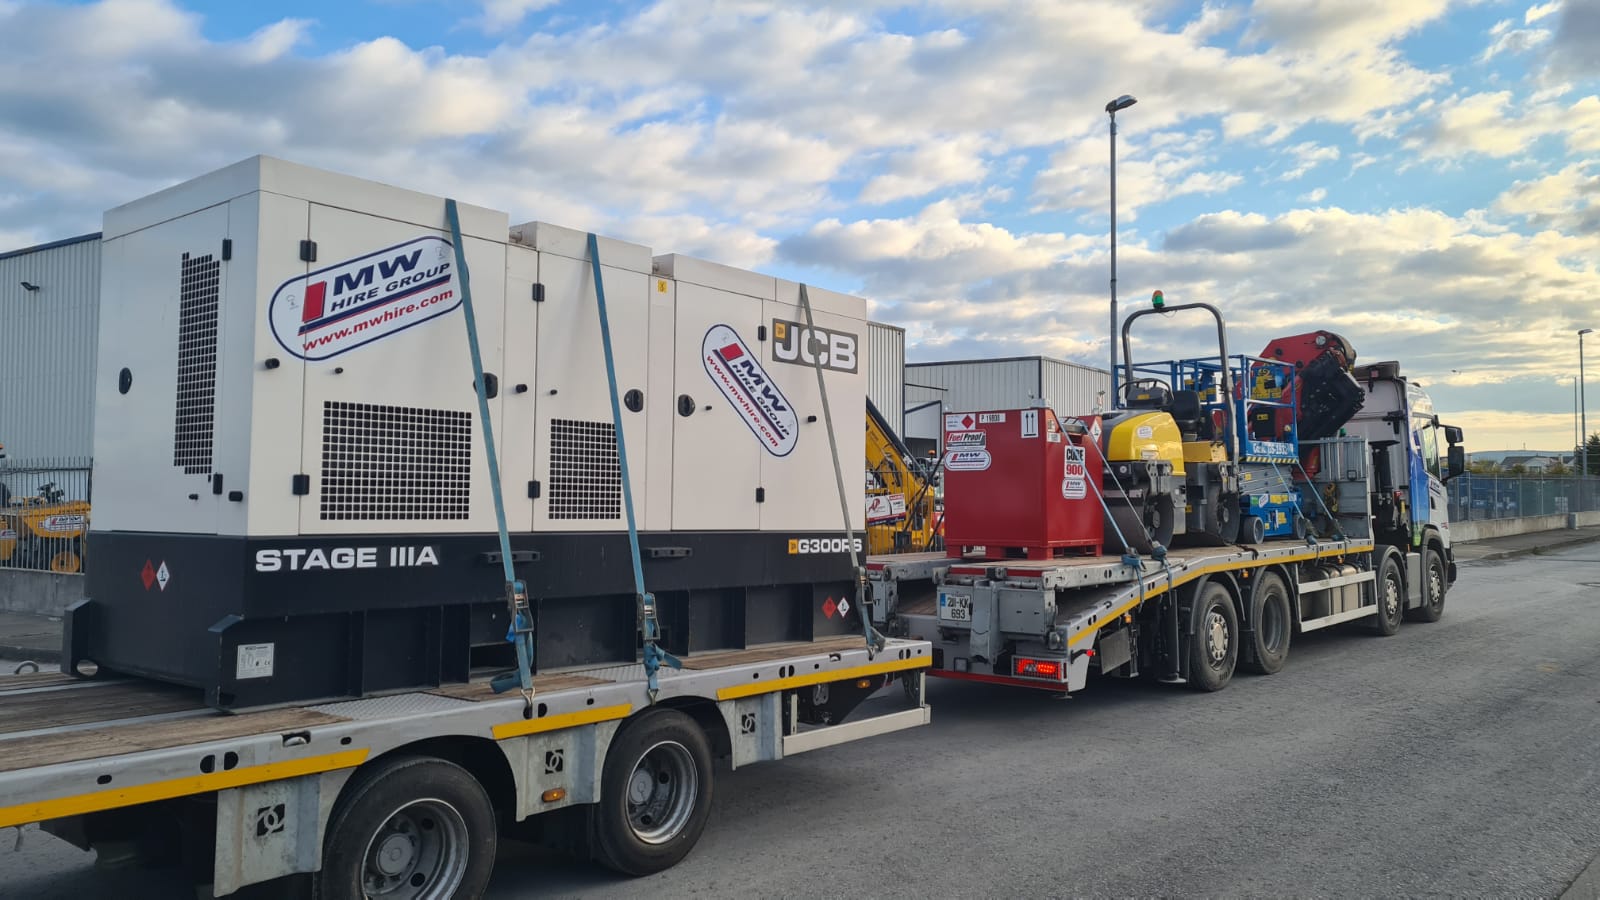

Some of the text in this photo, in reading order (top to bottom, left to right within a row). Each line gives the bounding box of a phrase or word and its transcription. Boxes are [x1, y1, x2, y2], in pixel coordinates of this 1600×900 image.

[331, 262, 450, 312] HIRE GROUP
[333, 249, 423, 296] MW
[302, 289, 453, 351] www.mwhire.com
[775, 325, 856, 369] JCB
[706, 355, 779, 447] www.mwhire.com
[732, 364, 790, 436] HIRE GROUP
[740, 360, 787, 412] MW
[949, 432, 983, 442] Fuel Proof
[1066, 464, 1083, 475] 900
[255, 546, 439, 572] STAGE IIIA
[951, 608, 965, 619] 693
